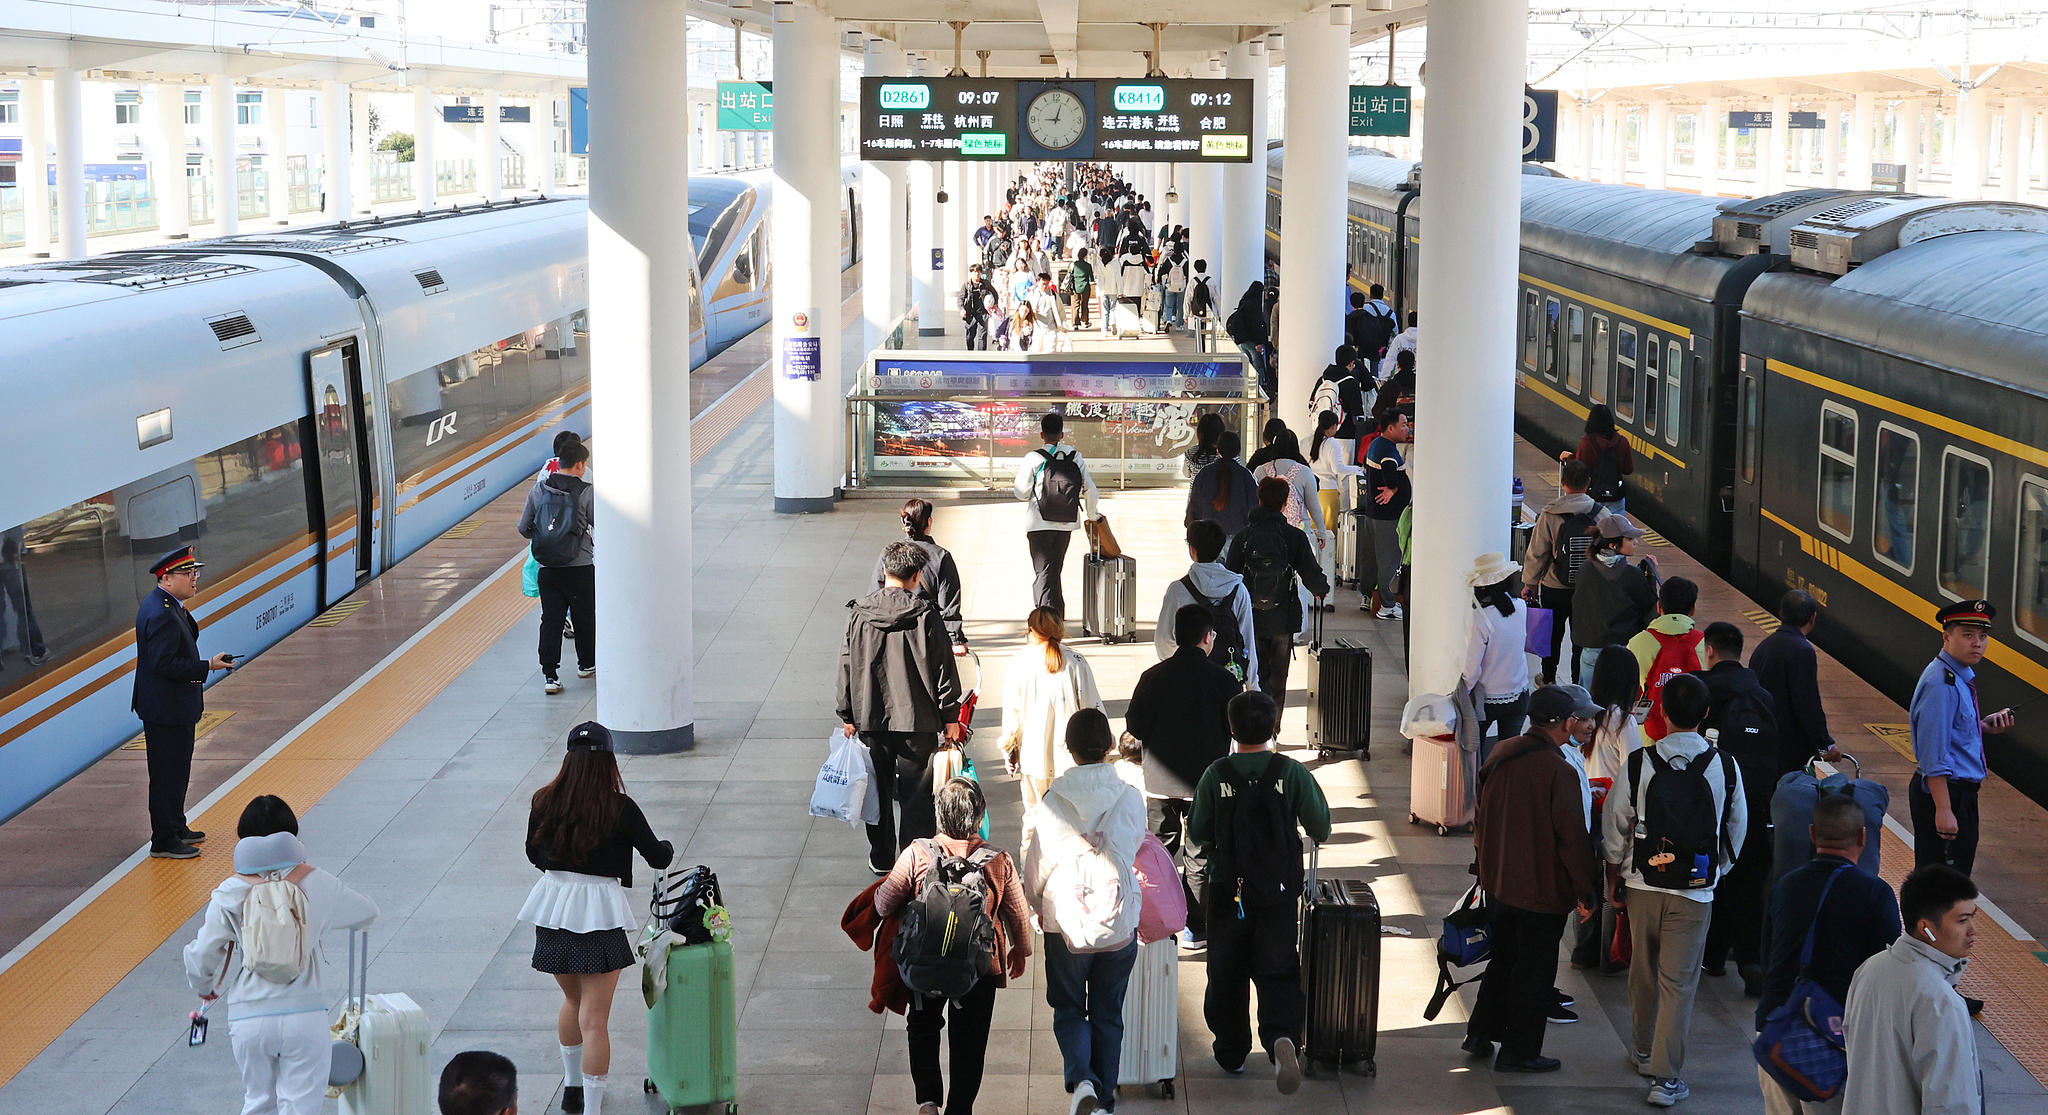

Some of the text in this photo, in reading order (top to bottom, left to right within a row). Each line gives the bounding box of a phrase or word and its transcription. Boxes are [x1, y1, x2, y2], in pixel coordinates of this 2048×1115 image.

[721, 90, 773, 109] 出站口
[883, 90, 925, 103] D2861
[957, 91, 1000, 105] 09:07
[1052, 93, 1061, 102] 12
[1118, 92, 1161, 105] K8414
[1190, 92, 1232, 106] 09:12
[1351, 95, 1407, 114] 出站口
[753, 111, 773, 123] Exi
[878, 113, 994, 128] 日照 开往 杭州西
[1030, 115, 1036, 124] 9
[1076, 116, 1082, 125] 3
[1101, 114, 1227, 130] 连云港东 开往 合肥
[1351, 116, 1374, 127] Exit
[963, 138, 1003, 149] 绿色地标
[1053, 138, 1059, 147] 6
[1009, 378, 1104, 388] 连云港站欢迎您
[426, 411, 458, 447] CR
